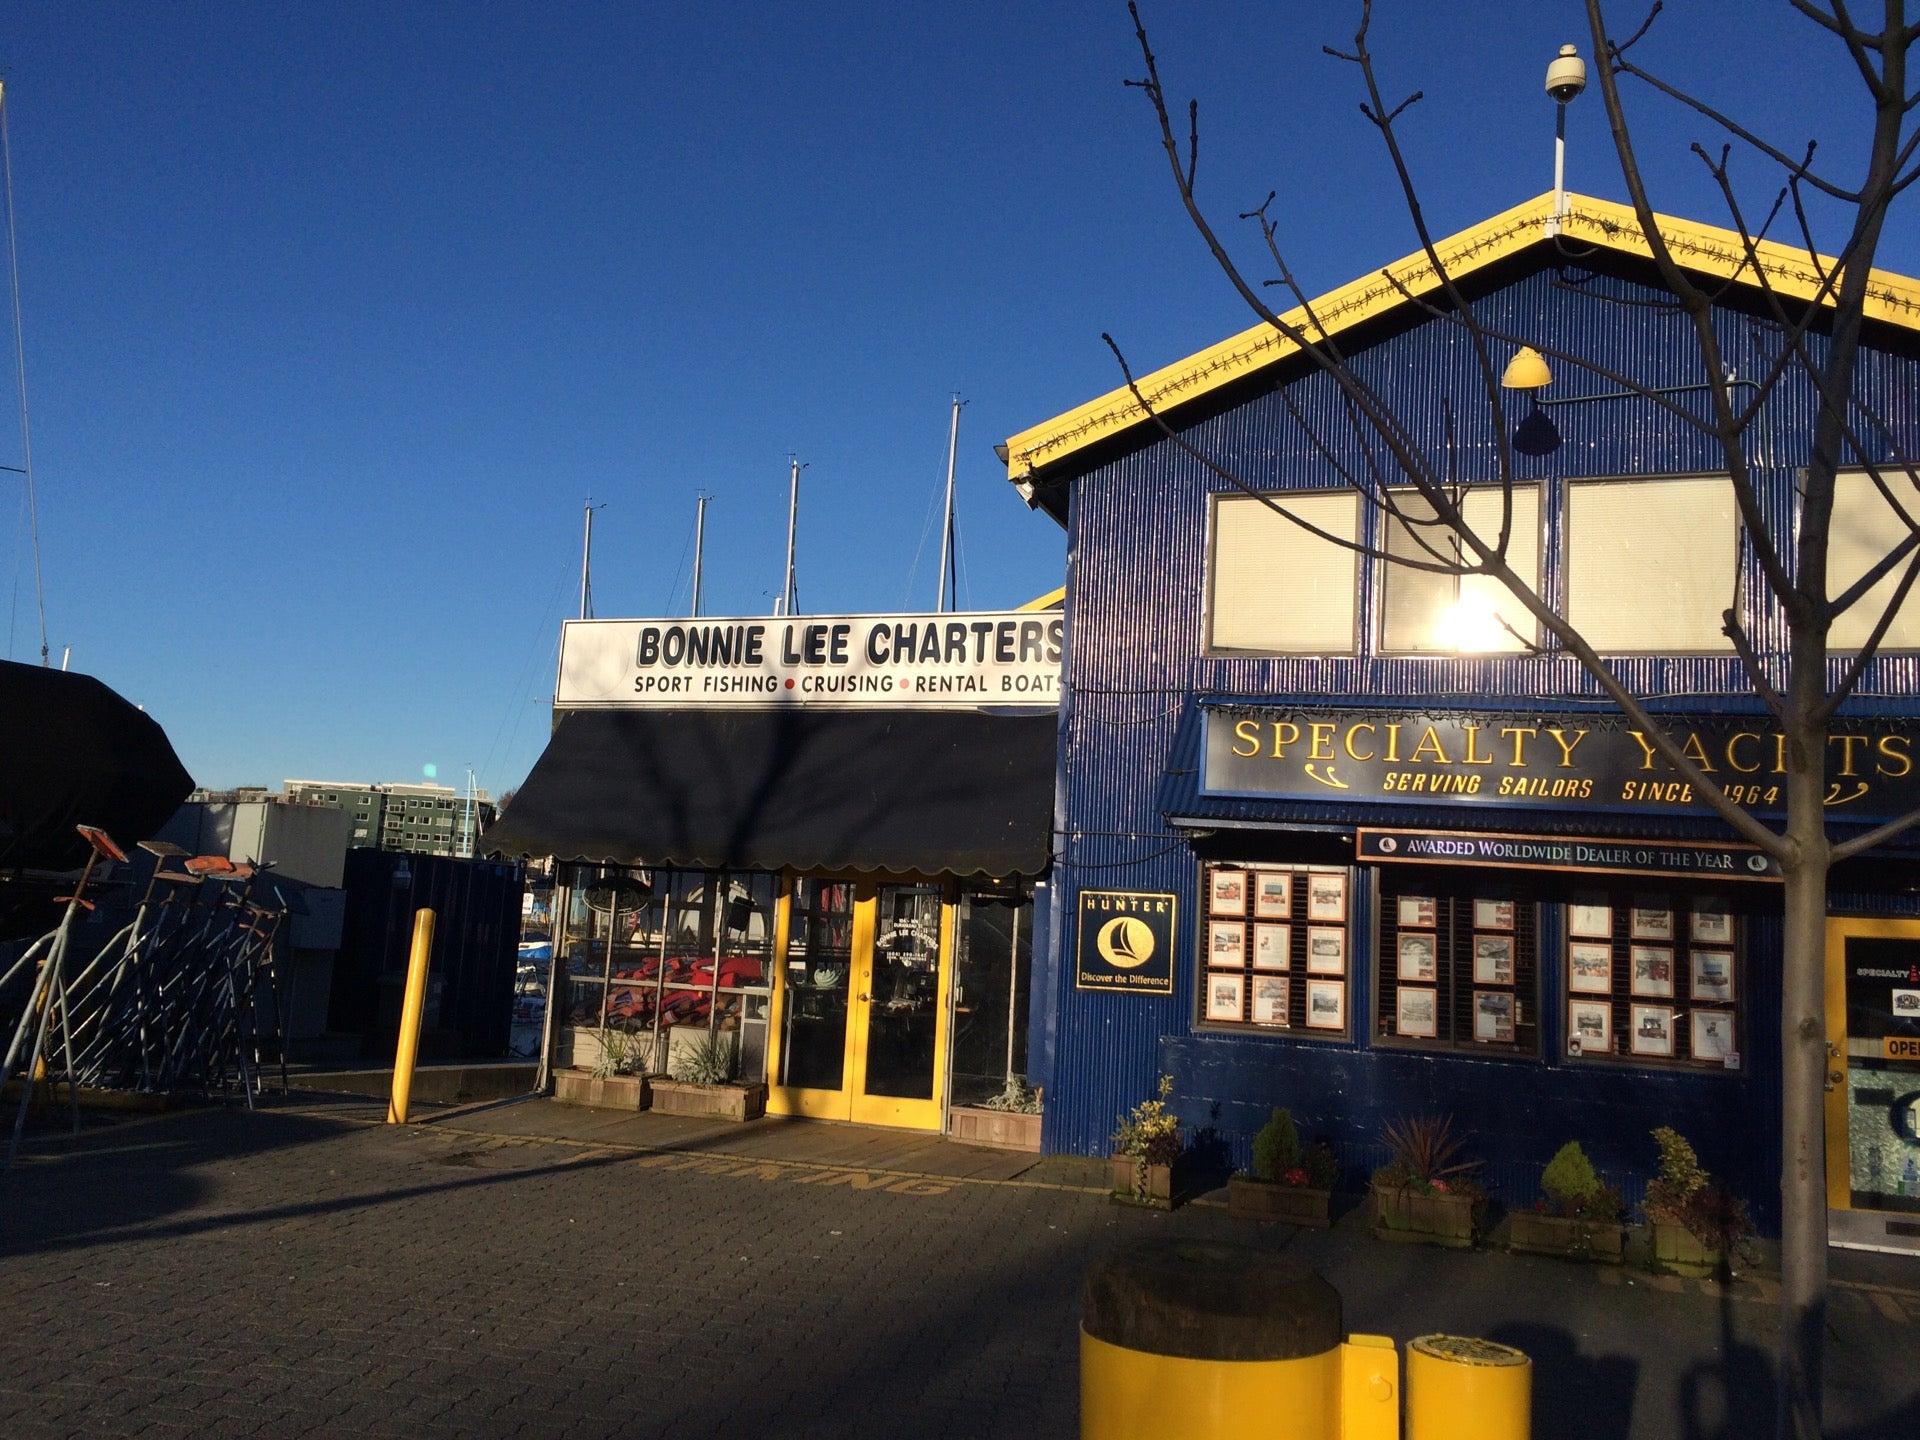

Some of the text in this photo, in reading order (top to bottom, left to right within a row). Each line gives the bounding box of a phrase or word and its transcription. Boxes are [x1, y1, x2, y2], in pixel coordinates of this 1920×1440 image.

[637, 619, 1065, 667] BONNIE LEE CHARTERS
[634, 675, 692, 692] SPORT
[704, 675, 778, 692] FISHING
[801, 675, 893, 693] CRUISING
[916, 675, 988, 692] RENTAL
[1232, 719, 1590, 768] SPECIALTY
[1383, 772, 1780, 806] SERVING SAILORS SINCE 1964
[1407, 839, 1735, 870] AWARDED WORLDWIDE DEALER OF THE YEAR
[1087, 899, 1165, 913] HUNTER
[1081, 971, 1169, 986] Discover the Difference
[1856, 967, 1910, 978] SPECIALTY
[1889, 1040, 1920, 1056] OPE
